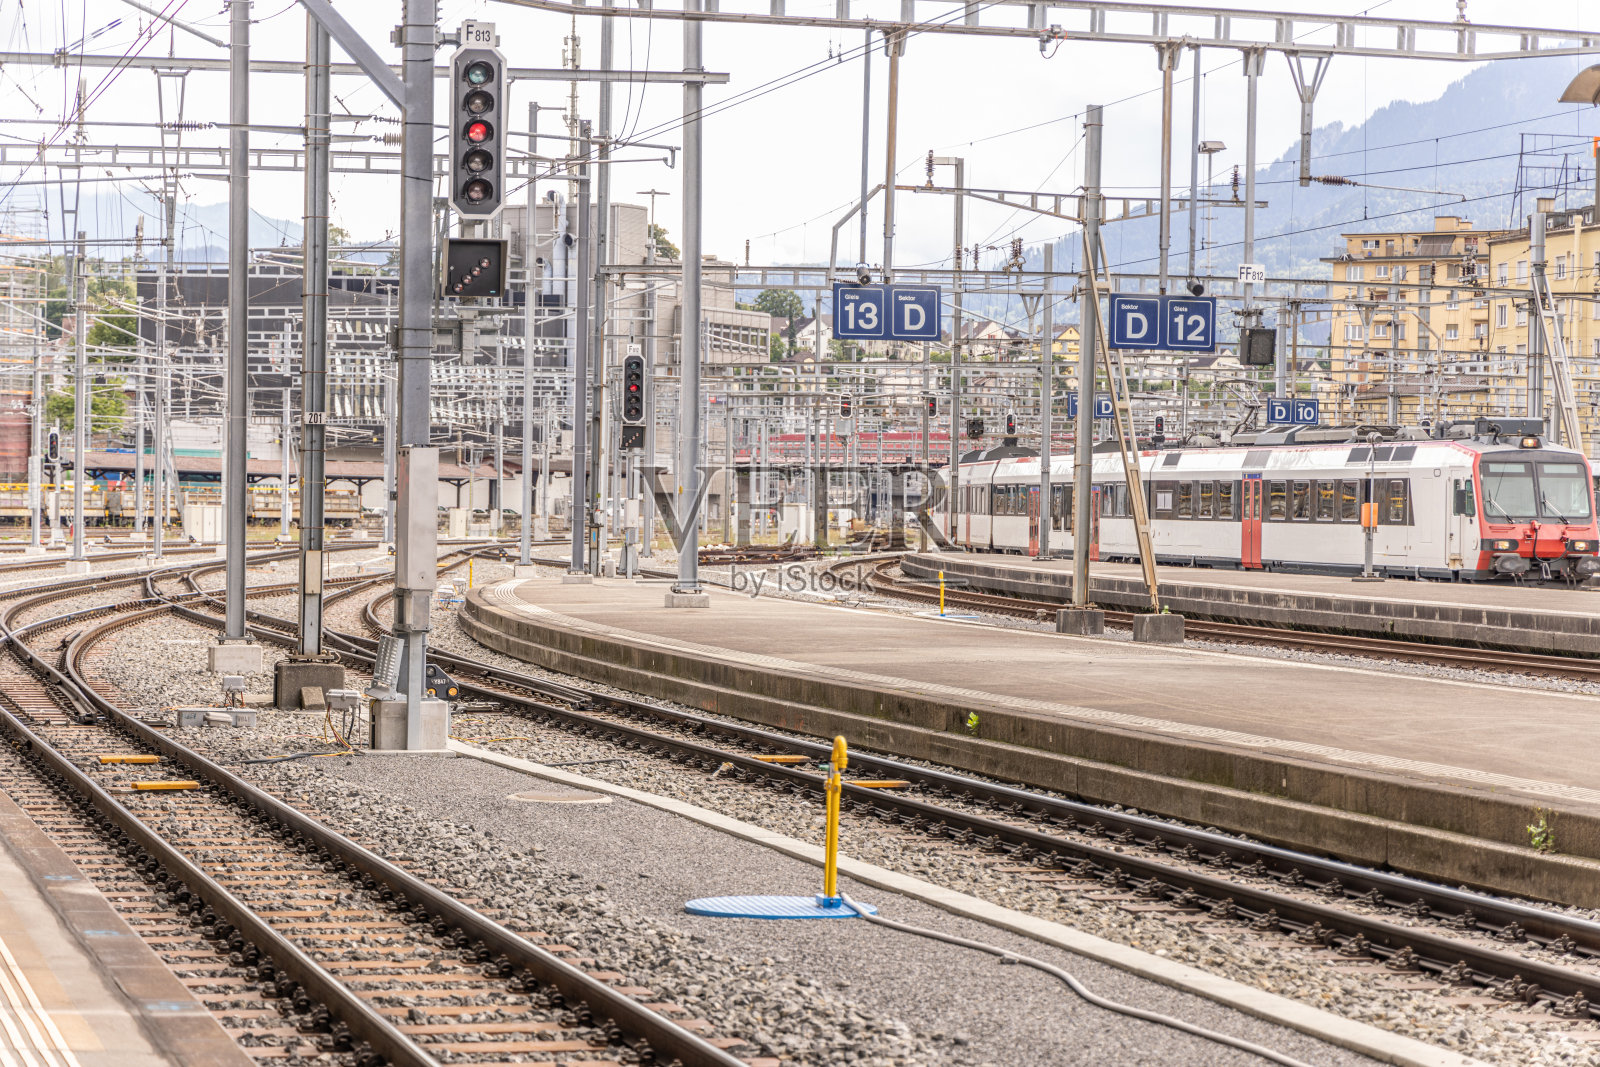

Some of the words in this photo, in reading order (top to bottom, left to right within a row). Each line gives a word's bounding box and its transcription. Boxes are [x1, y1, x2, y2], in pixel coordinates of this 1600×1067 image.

[844, 302, 878, 330] 13
[904, 303, 926, 331] D
[1126, 312, 1148, 339] D
[1173, 314, 1206, 341] 12
[1101, 400, 1113, 414] D
[1274, 406, 1287, 420] D
[1298, 406, 1315, 420] 10
[308, 412, 322, 424] 201
